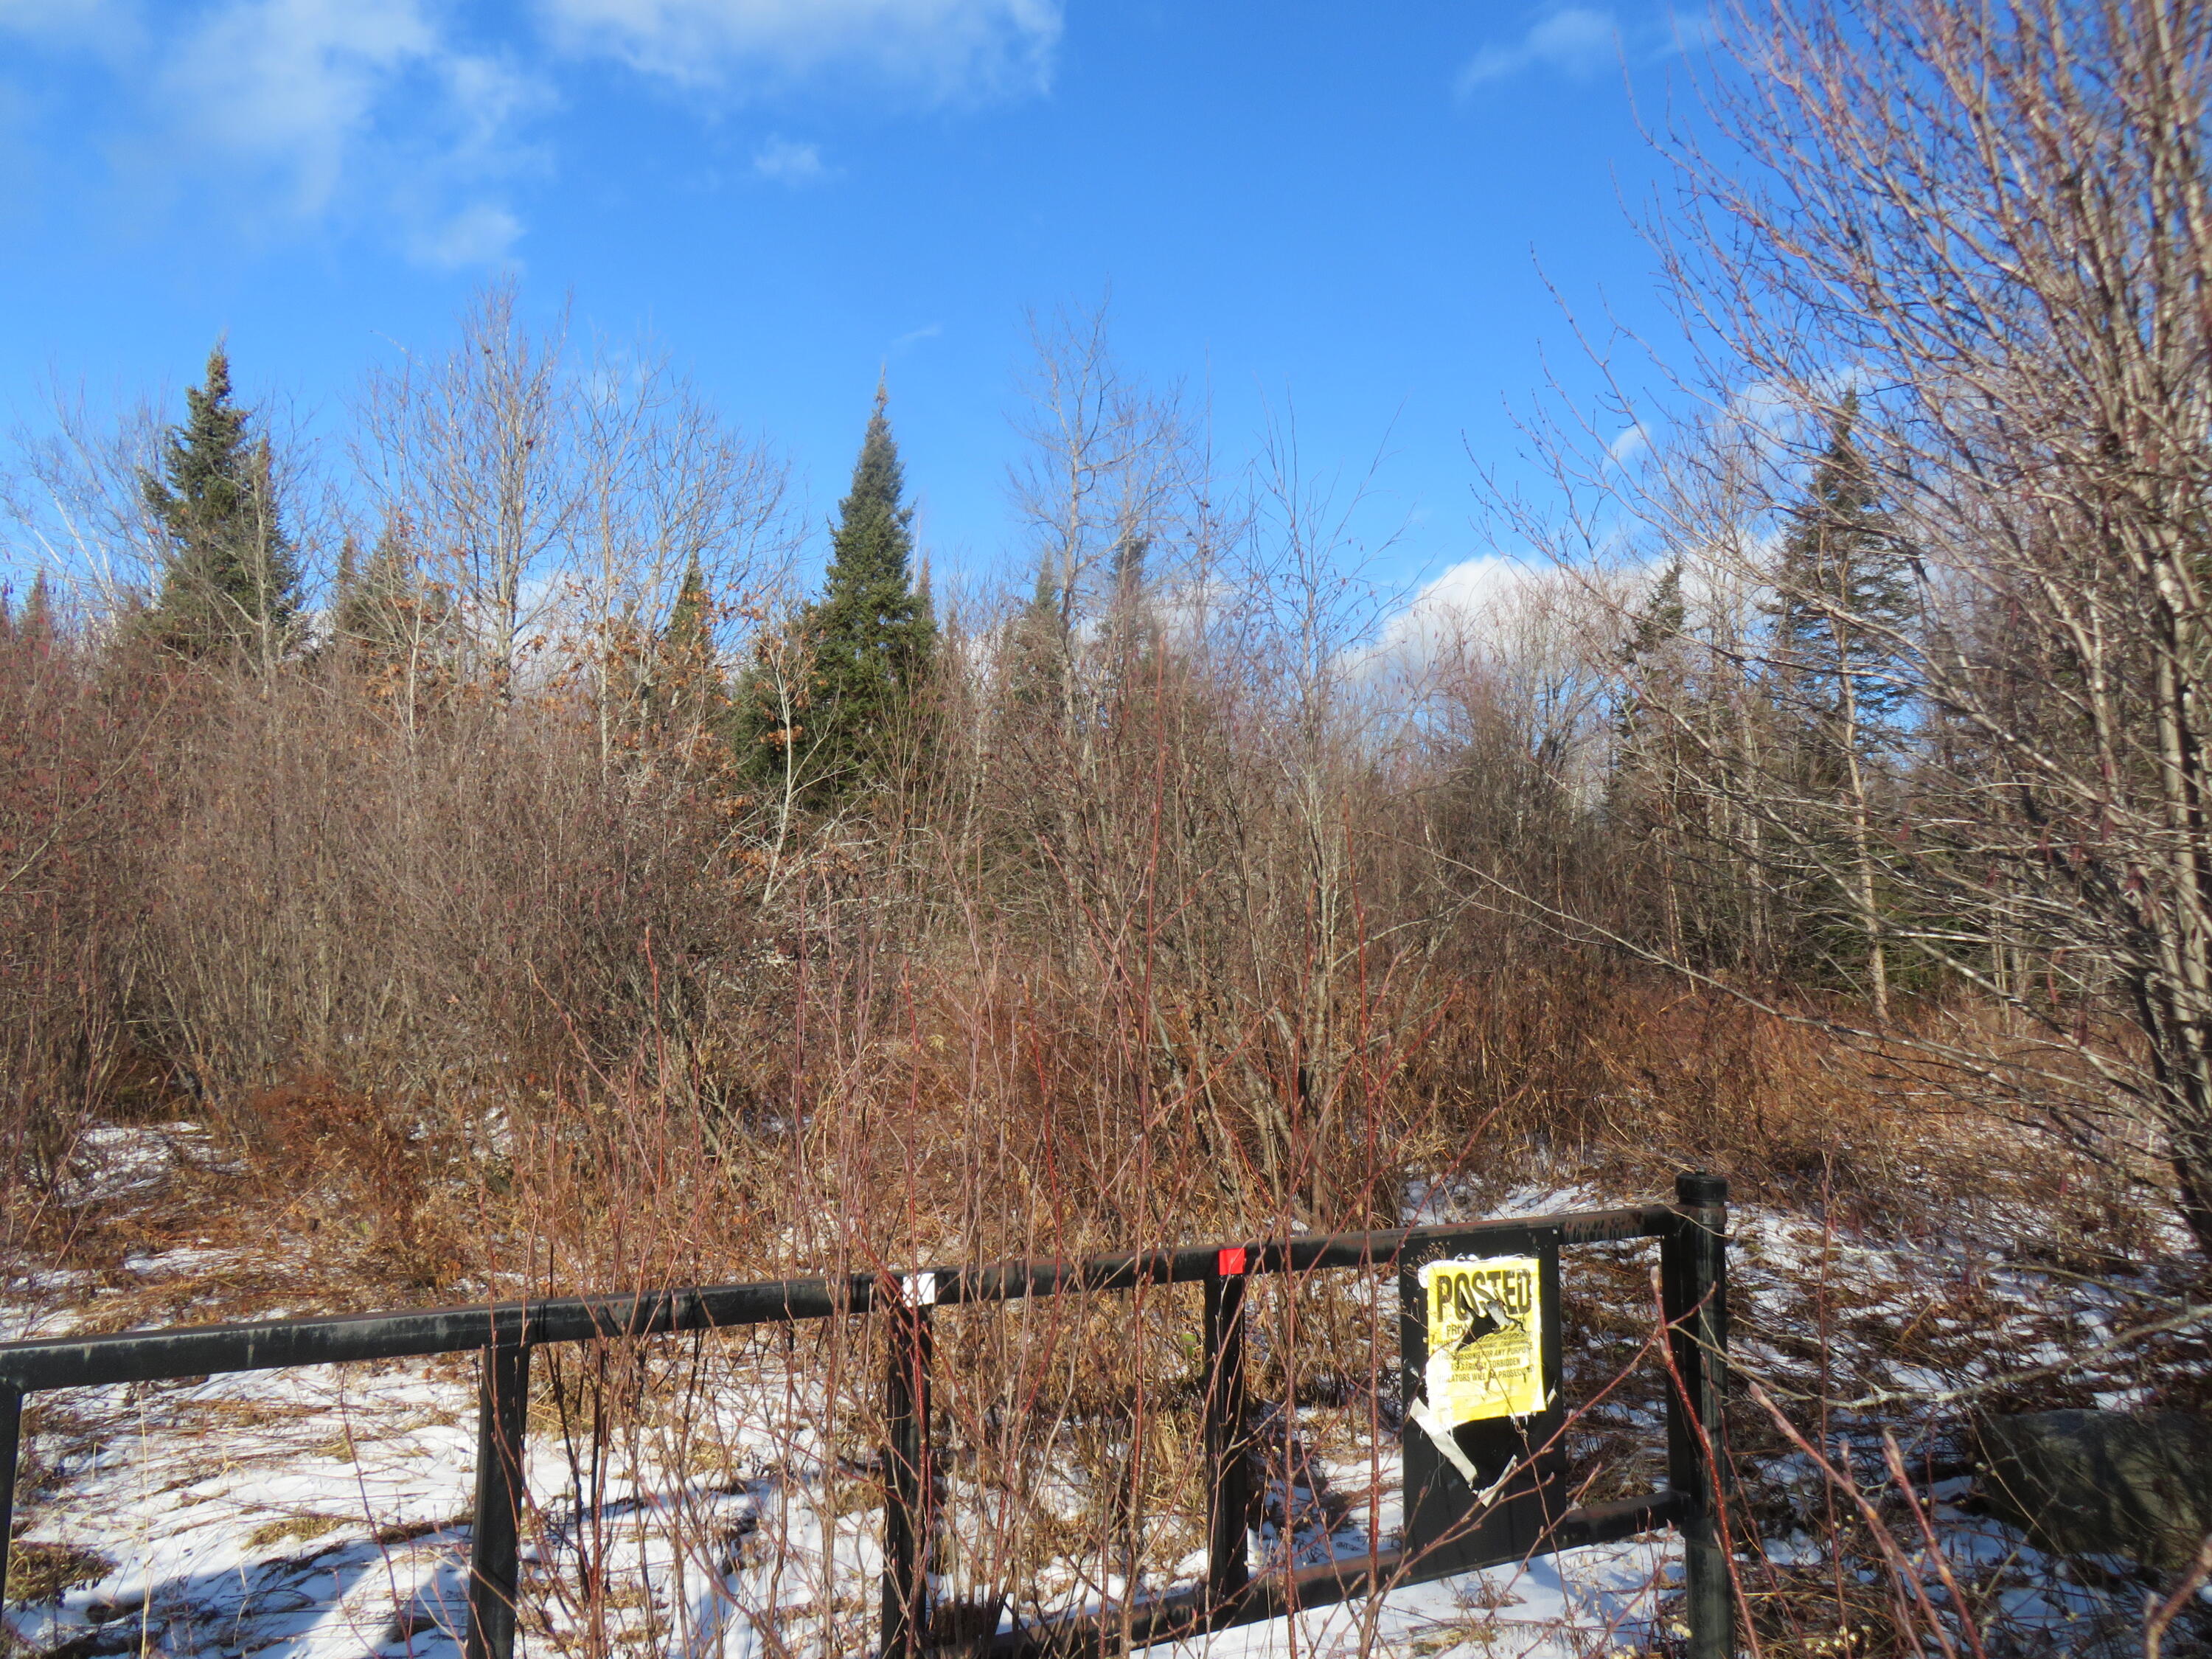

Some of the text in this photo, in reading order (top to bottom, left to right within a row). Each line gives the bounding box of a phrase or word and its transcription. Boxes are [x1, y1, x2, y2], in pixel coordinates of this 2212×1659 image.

[1437, 1268, 1532, 1323] POSTED
[1494, 1347, 1506, 1357] ANY
[1489, 1357, 1520, 1369] FORBIDDEN
[1472, 1371, 1486, 1382] WILL
